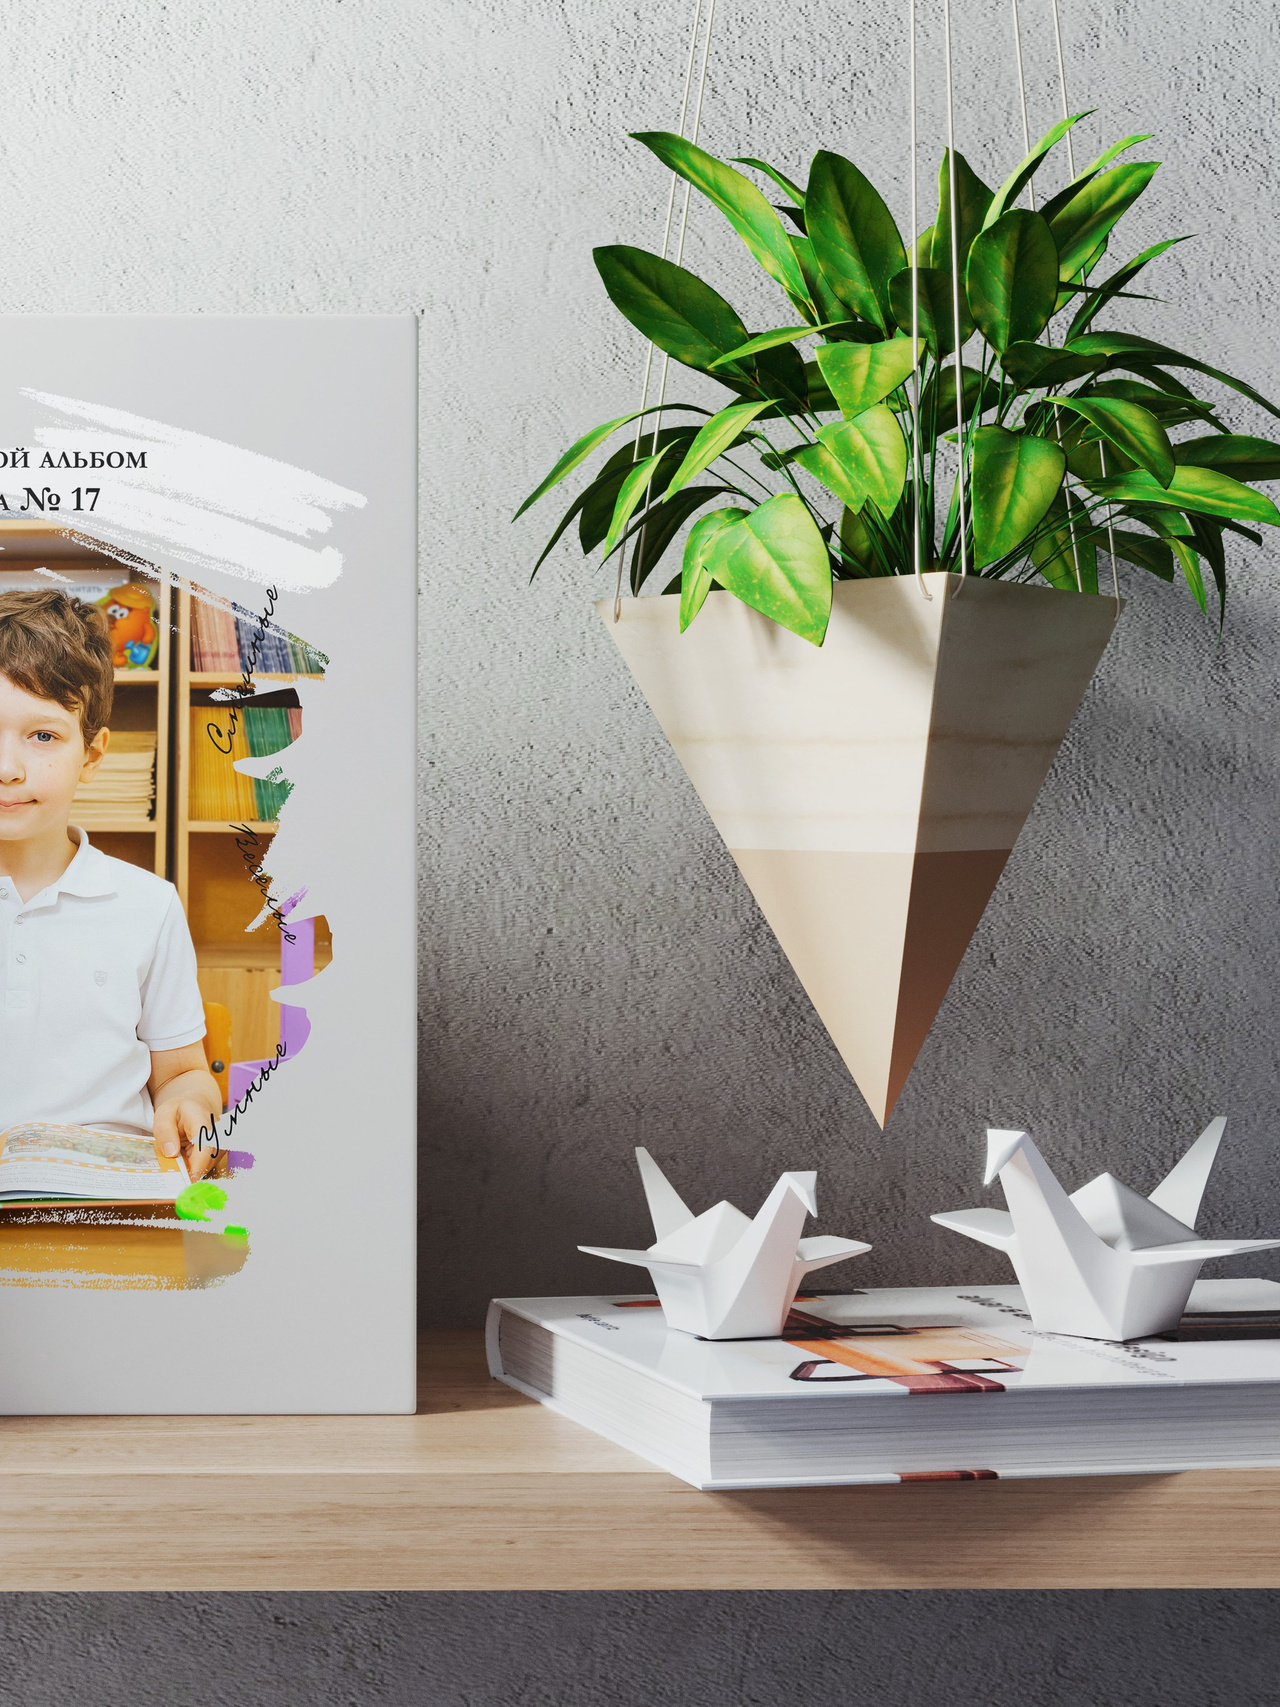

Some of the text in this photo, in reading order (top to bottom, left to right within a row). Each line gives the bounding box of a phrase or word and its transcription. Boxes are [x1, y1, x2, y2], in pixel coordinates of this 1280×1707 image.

[20, 486, 61, 512] №
[71, 487, 101, 512] 17
[206, 584, 279, 755] Смешные
[198, 1040, 287, 1159] Умные
